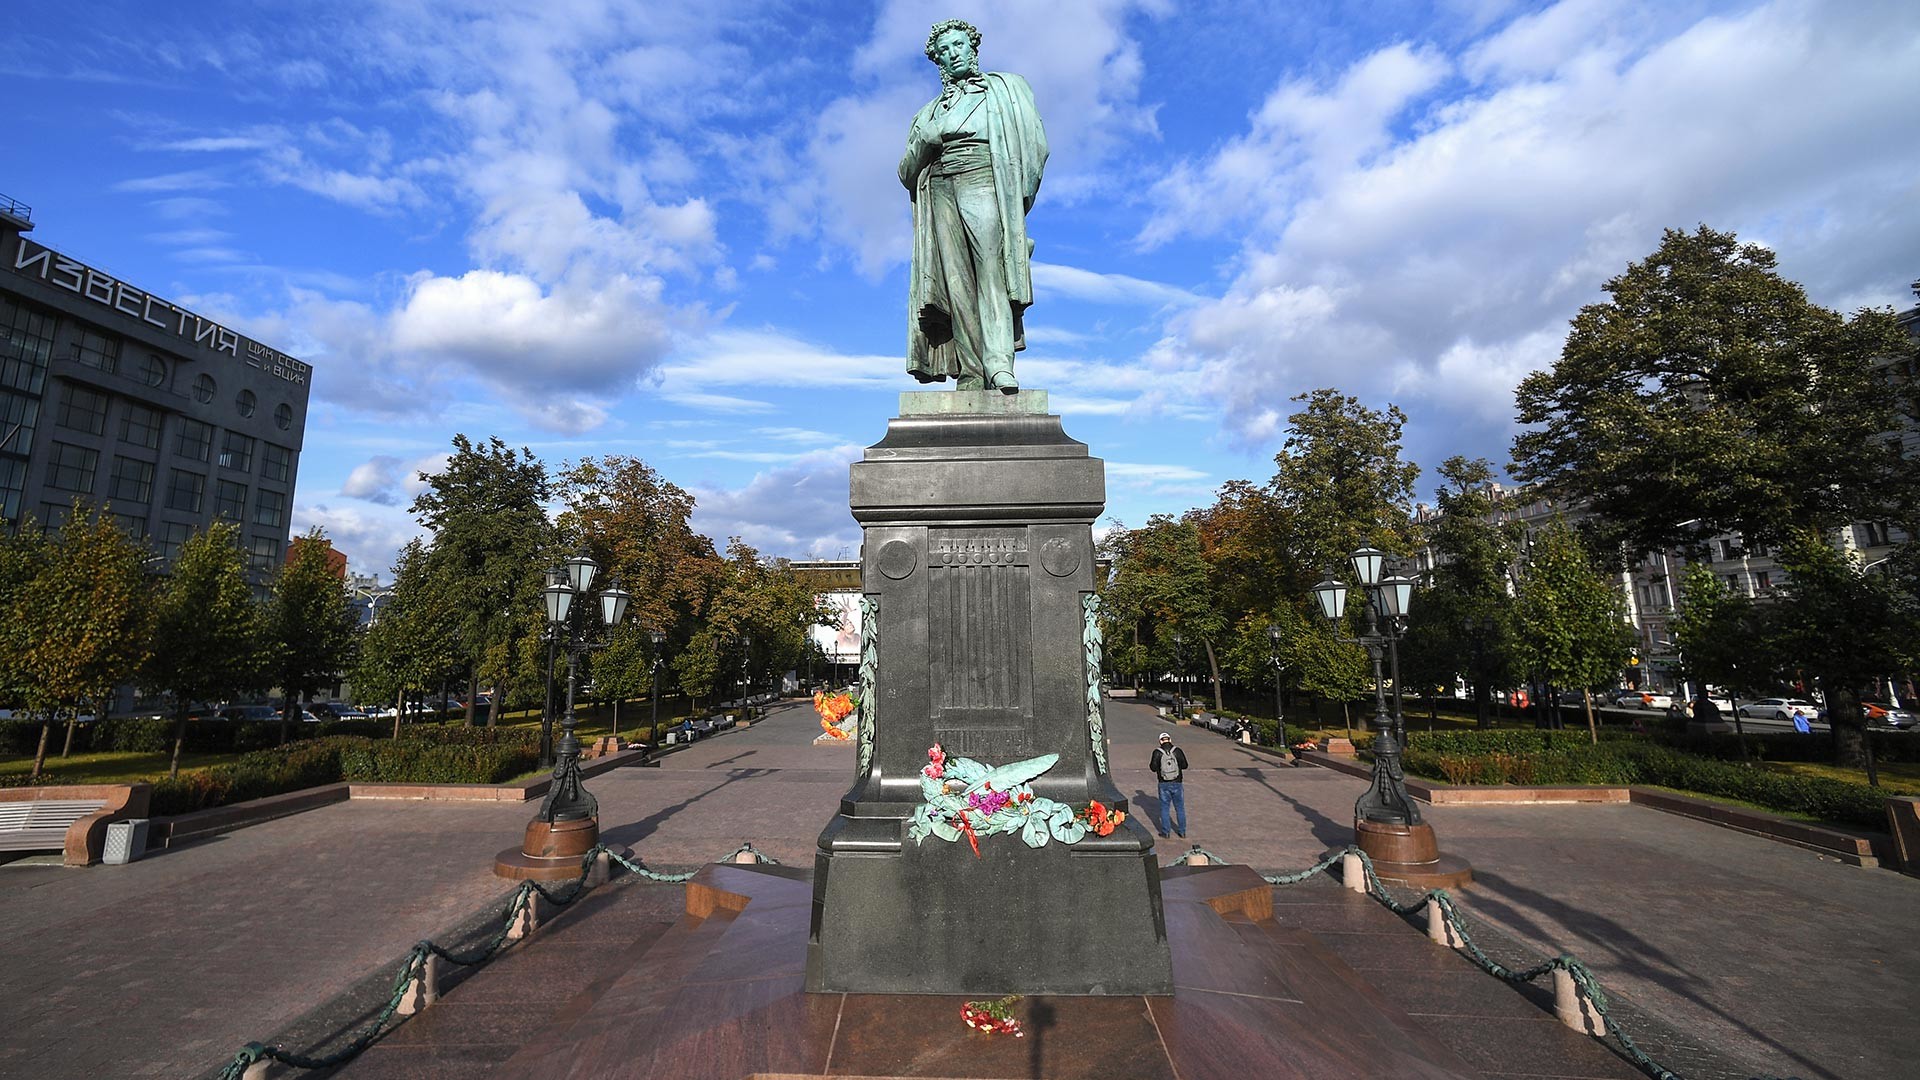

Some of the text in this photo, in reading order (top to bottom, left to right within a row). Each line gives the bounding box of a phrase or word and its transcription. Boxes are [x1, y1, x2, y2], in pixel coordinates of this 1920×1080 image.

[15, 240, 239, 357] ИЗВЕСТИЯ
[248, 341, 307, 373] ЦИК СССР
[273, 365, 305, 386] ВЦИК
